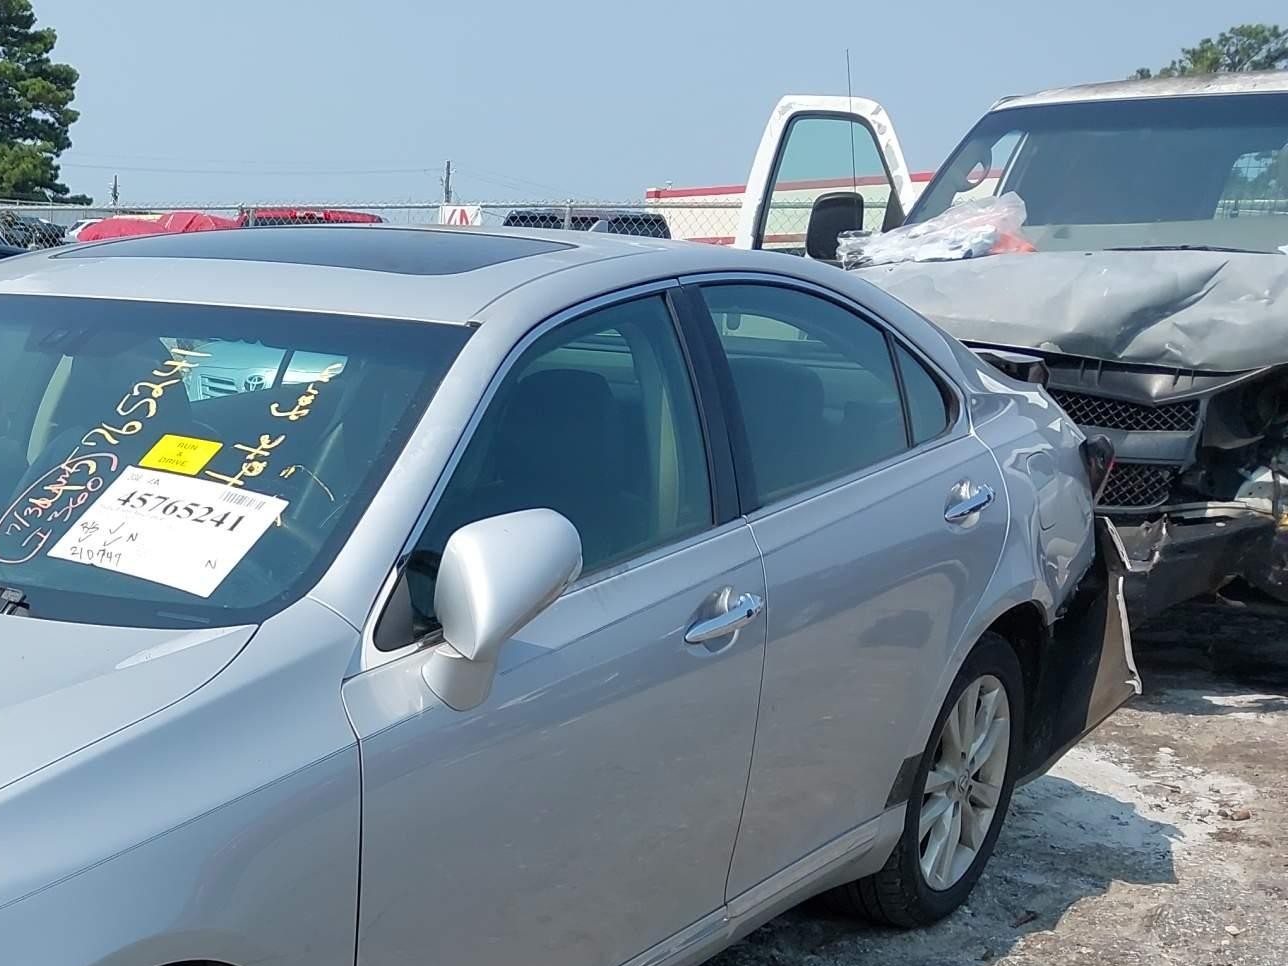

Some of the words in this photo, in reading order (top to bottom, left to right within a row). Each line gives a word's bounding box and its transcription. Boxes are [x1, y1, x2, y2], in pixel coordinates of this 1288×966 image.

[176, 442, 198, 451] RUN
[157, 456, 187, 467] DRIVE
[117, 489, 246, 532] 45765241
